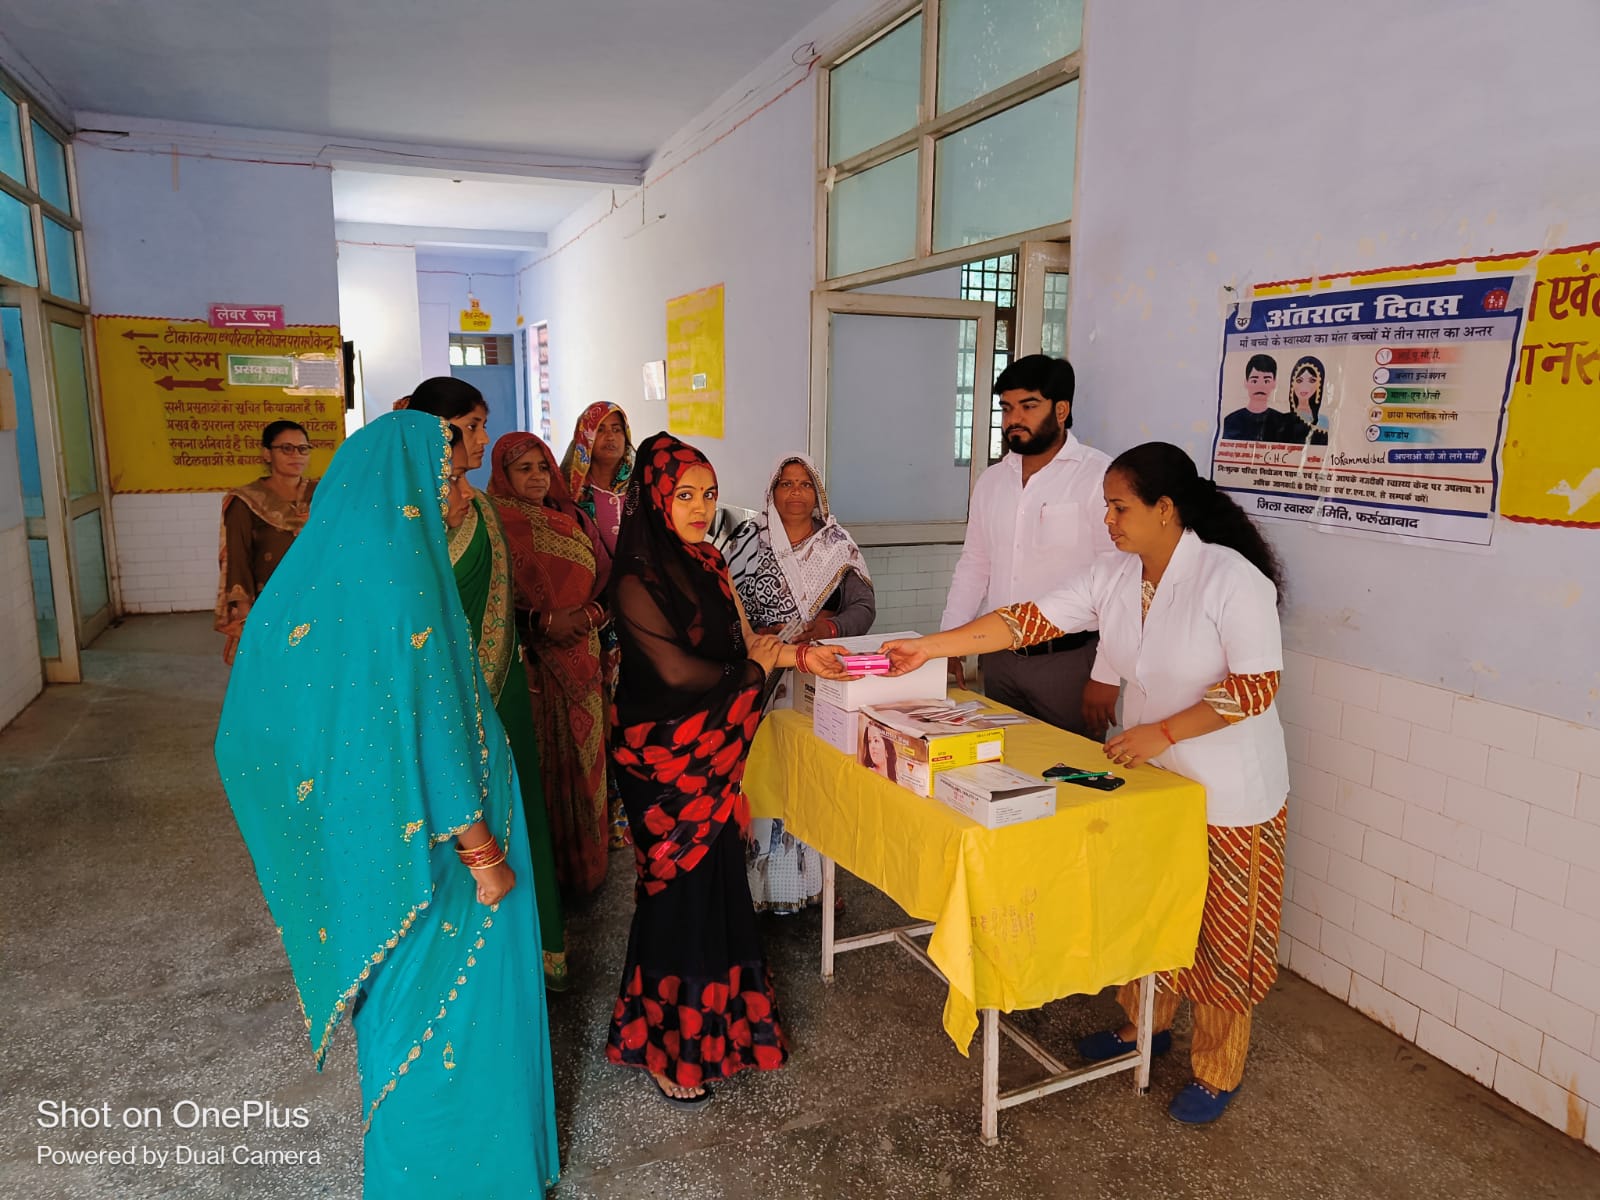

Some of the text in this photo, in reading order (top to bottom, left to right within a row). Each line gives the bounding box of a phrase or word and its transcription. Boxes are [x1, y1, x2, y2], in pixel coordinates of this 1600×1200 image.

[251, 310, 277, 322] रूम
[1265, 294, 1463, 328] अंतराल दिवस
[1271, 334, 1281, 346] के
[1314, 334, 1328, 344] का
[1351, 328, 1379, 341] बच्चों
[1381, 326, 1392, 340] में
[1394, 326, 1414, 340] तीन
[1416, 328, 1441, 339] साल
[1443, 327, 1461, 338] का
[1463, 326, 1495, 337] अन्तर
[1257, 496, 1281, 511] जिला
